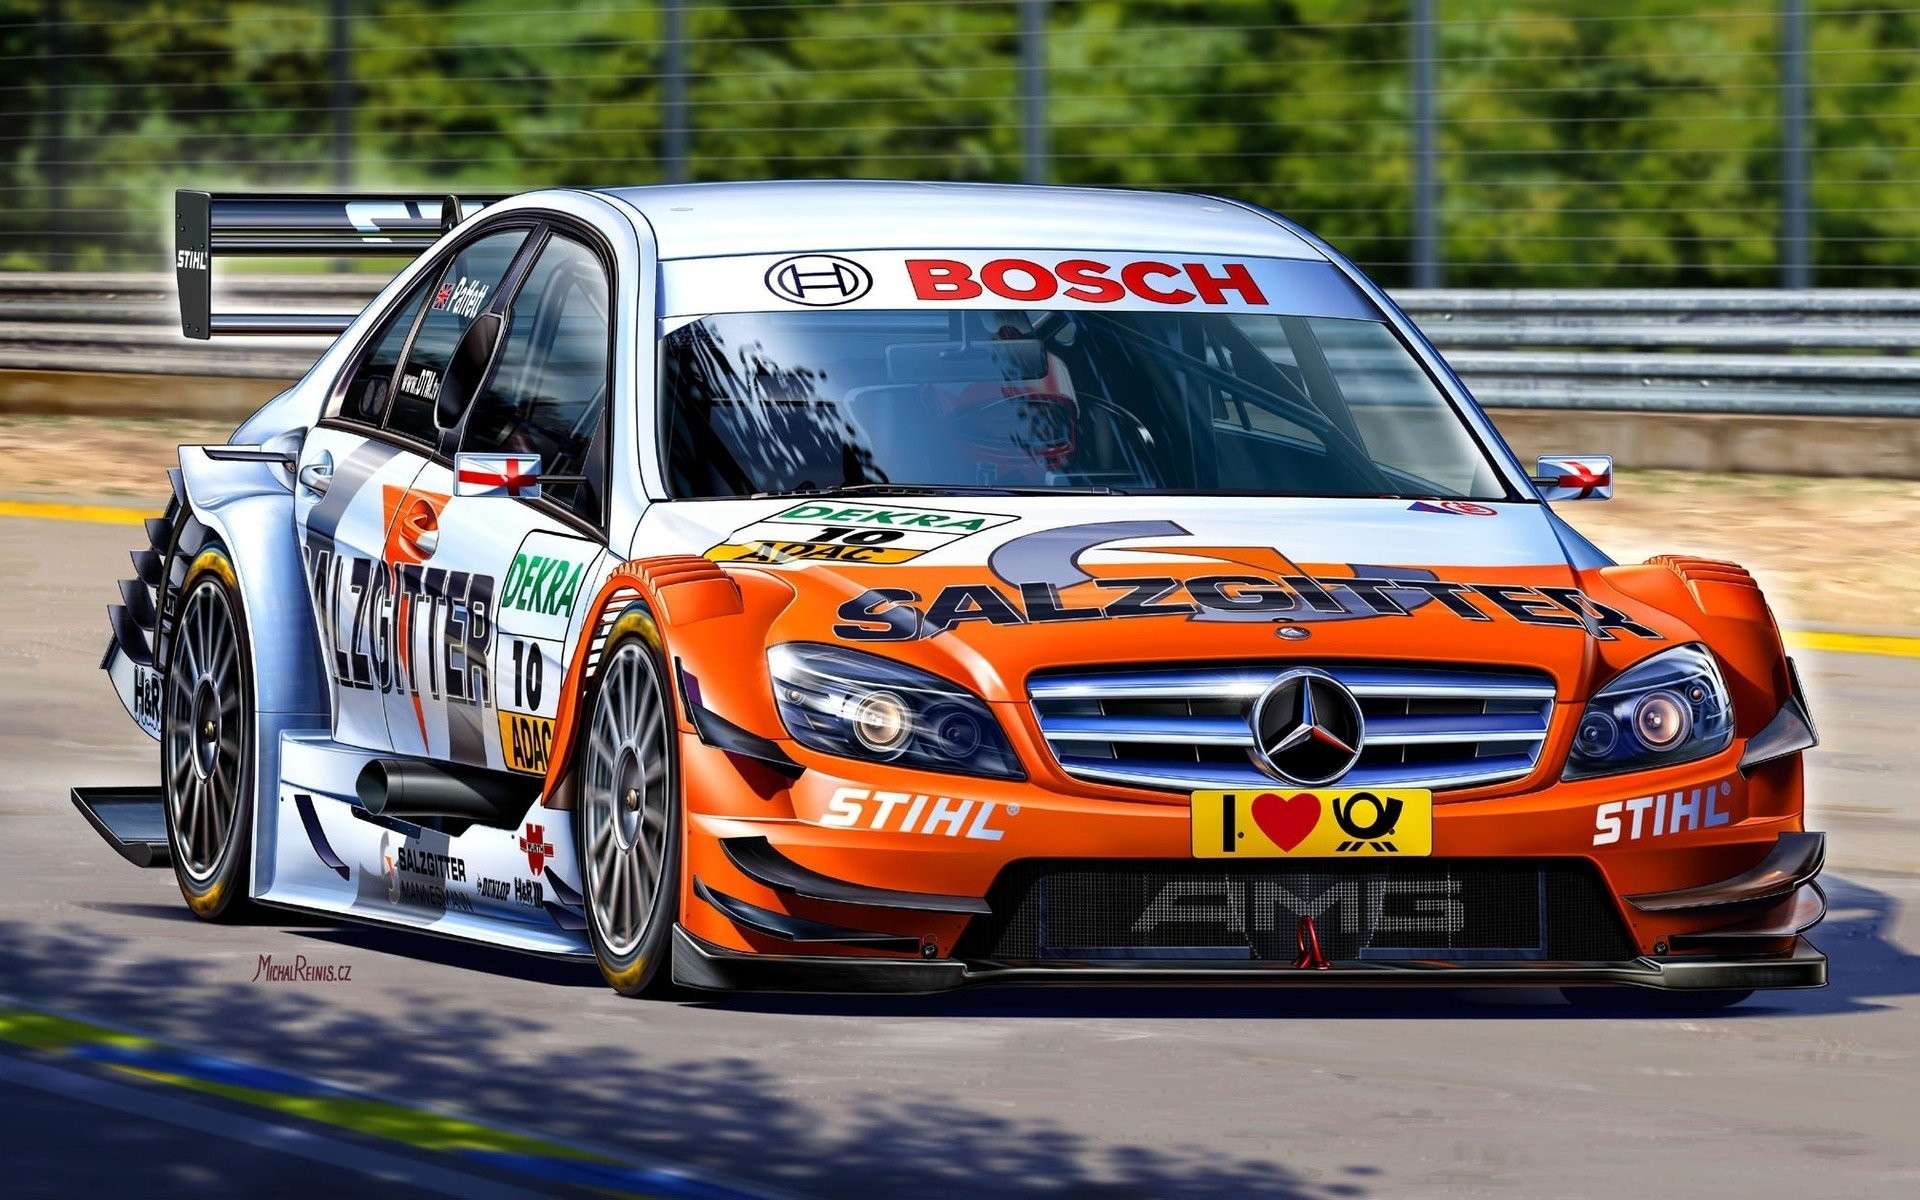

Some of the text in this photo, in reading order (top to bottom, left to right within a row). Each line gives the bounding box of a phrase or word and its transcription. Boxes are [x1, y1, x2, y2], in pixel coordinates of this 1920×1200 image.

[177, 250, 207, 270] STIHL
[904, 258, 1269, 306] BOSCH
[446, 276, 489, 319] Paffett
[779, 505, 986, 531] DEKRA
[807, 527, 905, 545] 10
[733, 540, 886, 562] ADAC
[502, 553, 584, 618] DEKRA
[833, 574, 1664, 644] SALZGITTER
[302, 545, 496, 708] ALZGITTER
[512, 640, 543, 711] 10
[511, 716, 552, 771] ADAC
[819, 788, 1005, 841] STIHL
[1593, 786, 1730, 846] STIHL
[398, 847, 466, 883] SALZGITTER
[482, 877, 511, 900] DUNLOP
[401, 880, 475, 913] MANNESMANN
[1131, 881, 1465, 932] AMG
